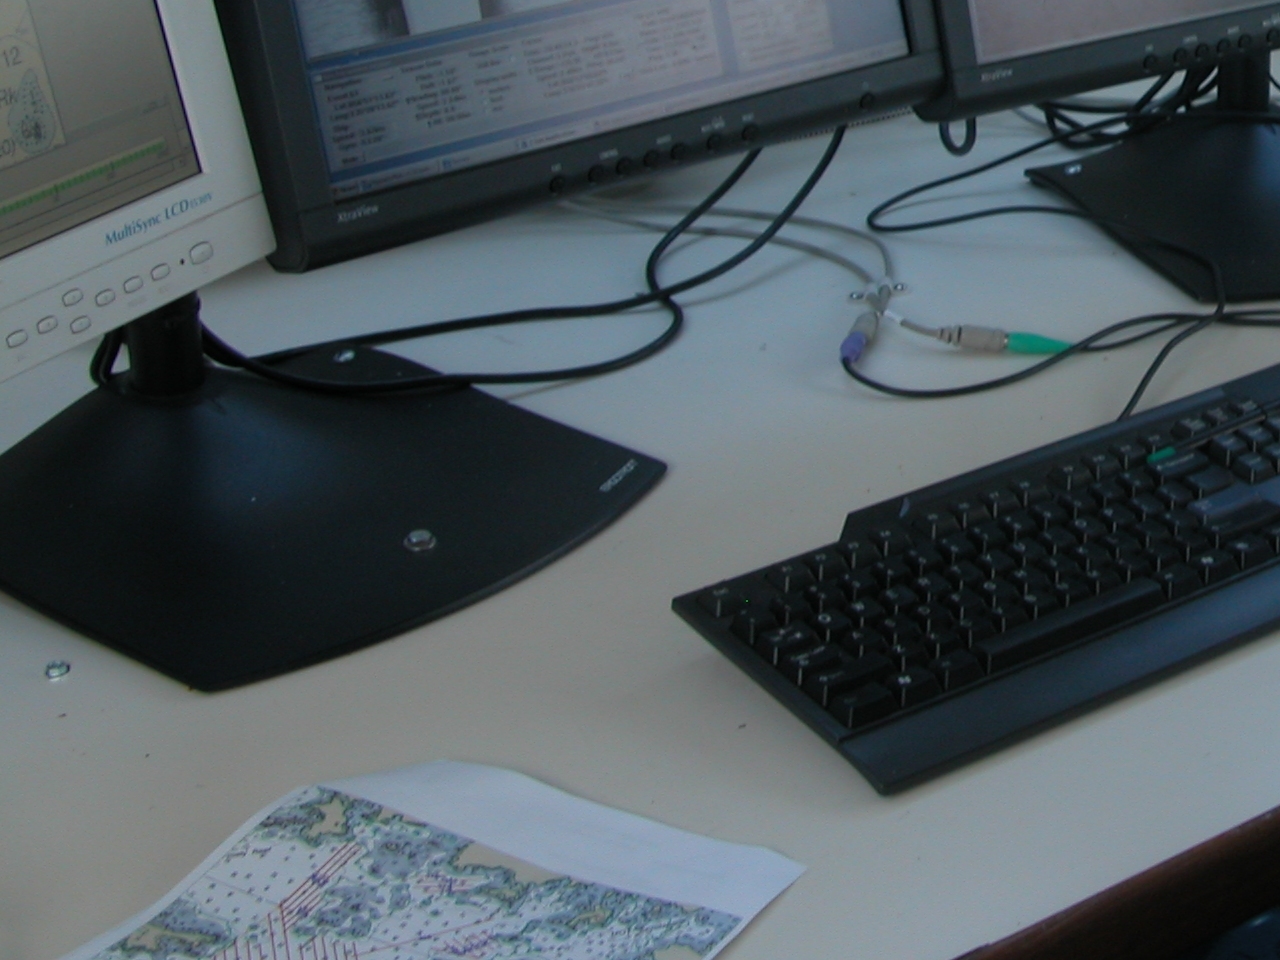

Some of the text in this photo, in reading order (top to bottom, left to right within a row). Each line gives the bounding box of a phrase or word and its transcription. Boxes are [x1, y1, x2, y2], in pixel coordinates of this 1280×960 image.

[2, 46, 23, 68] 12
[104, 213, 162, 246] MultiSync
[164, 198, 190, 221] LCD
